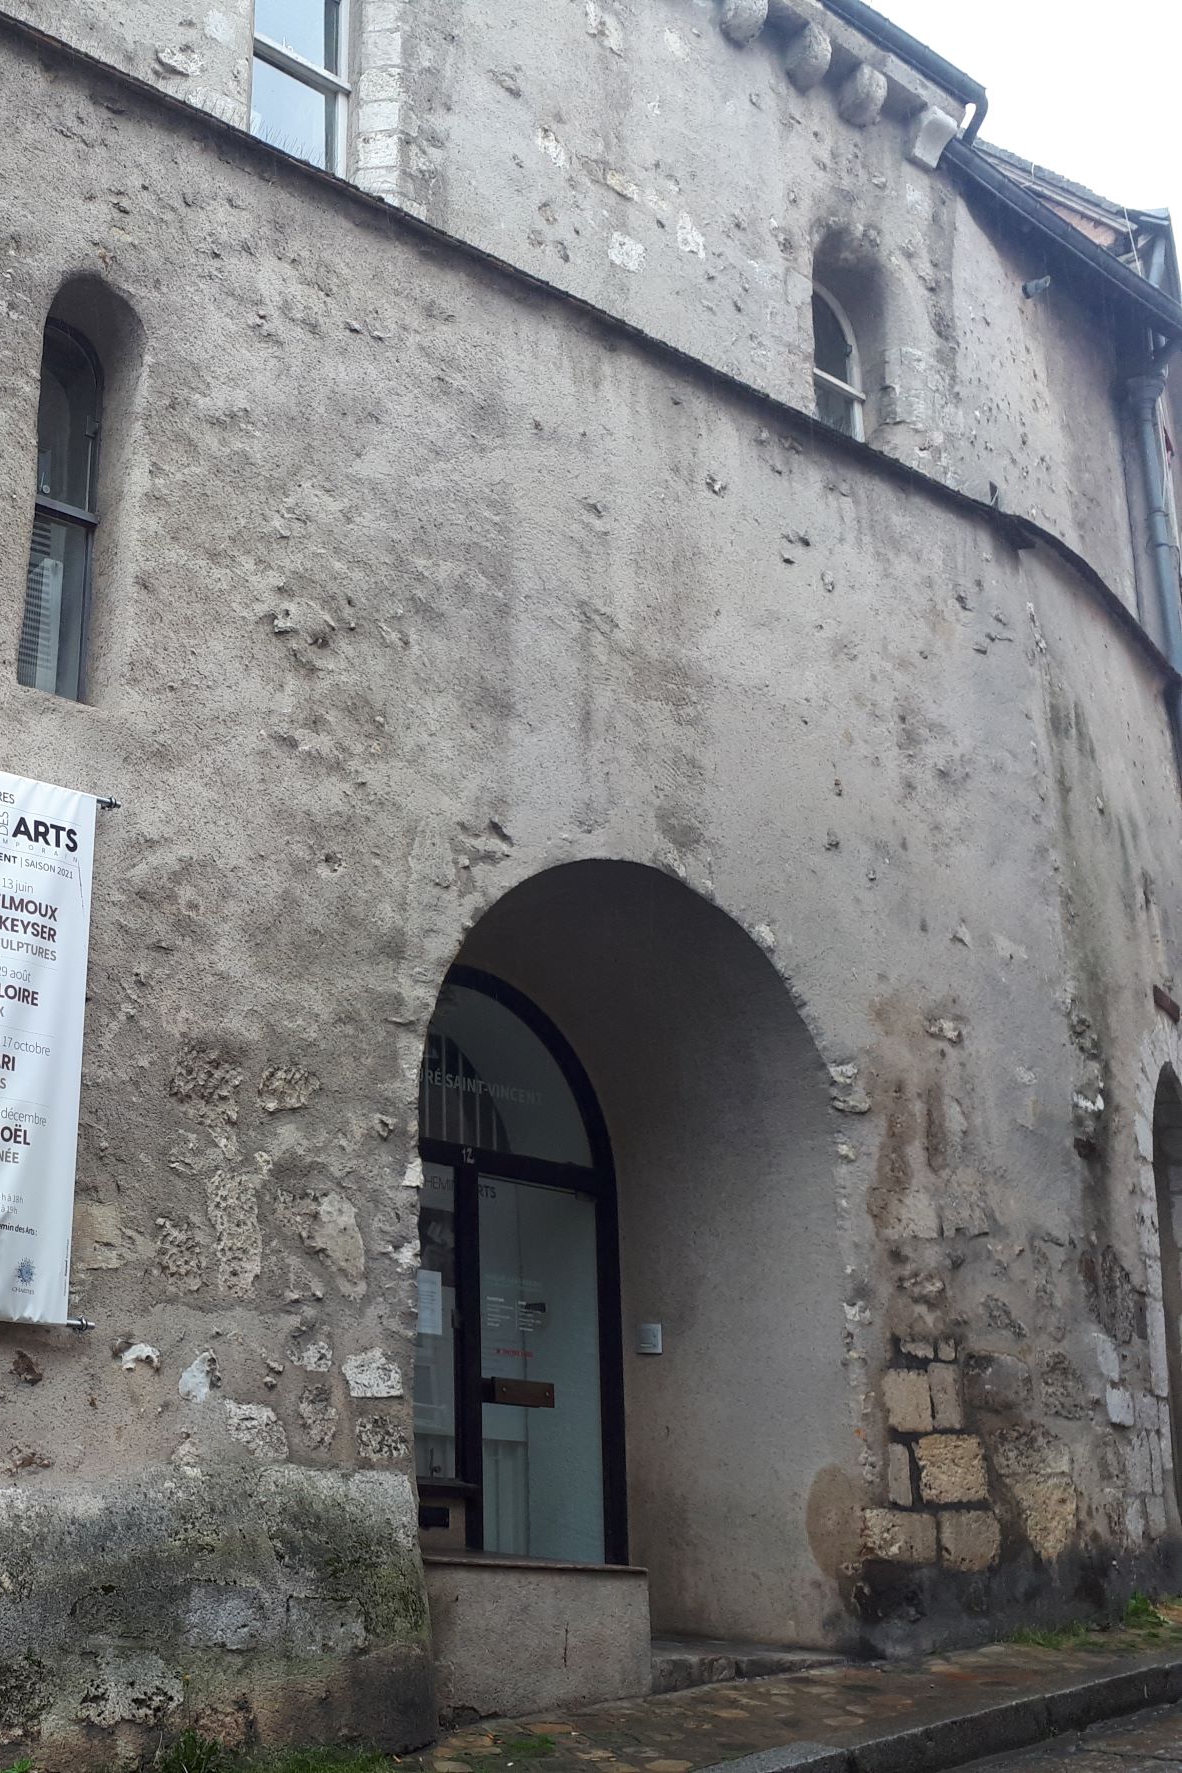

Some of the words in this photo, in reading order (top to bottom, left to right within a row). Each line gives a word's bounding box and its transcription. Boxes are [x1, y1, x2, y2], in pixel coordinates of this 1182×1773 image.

[11, 816, 78, 853] ARTS
[24, 858, 56, 873] SAISON
[57, 866, 73, 879] 2021
[1, 877, 14, 890] 13
[14, 880, 34, 894] juin
[9, 969, 32, 983] août
[2, 1035, 13, 1048] 17
[13, 1041, 51, 1057] octobre
[0, 1106, 47, 1127] décembre
[461, 1147, 474, 1165] 12
[14, 1224, 25, 1234] des
